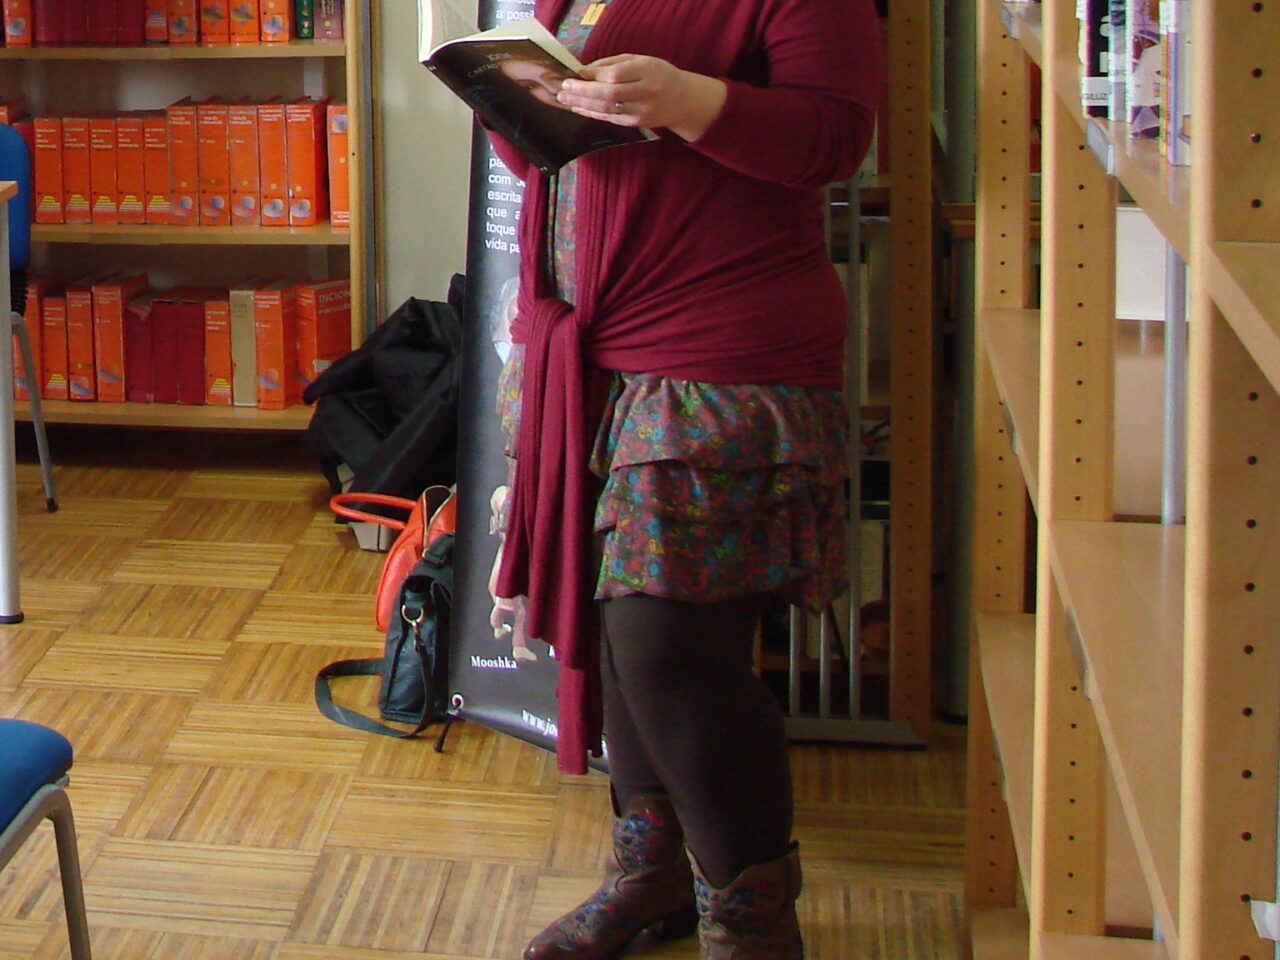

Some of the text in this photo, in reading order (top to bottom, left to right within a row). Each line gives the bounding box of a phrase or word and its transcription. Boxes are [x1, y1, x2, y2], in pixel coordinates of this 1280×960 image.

[496, 10, 503, 19] a
[488, 174, 511, 185] com
[487, 190, 521, 203] escrita
[486, 206, 508, 218] que
[486, 221, 515, 236] toque
[485, 238, 508, 251] vida
[470, 655, 518, 669] Mooshka
